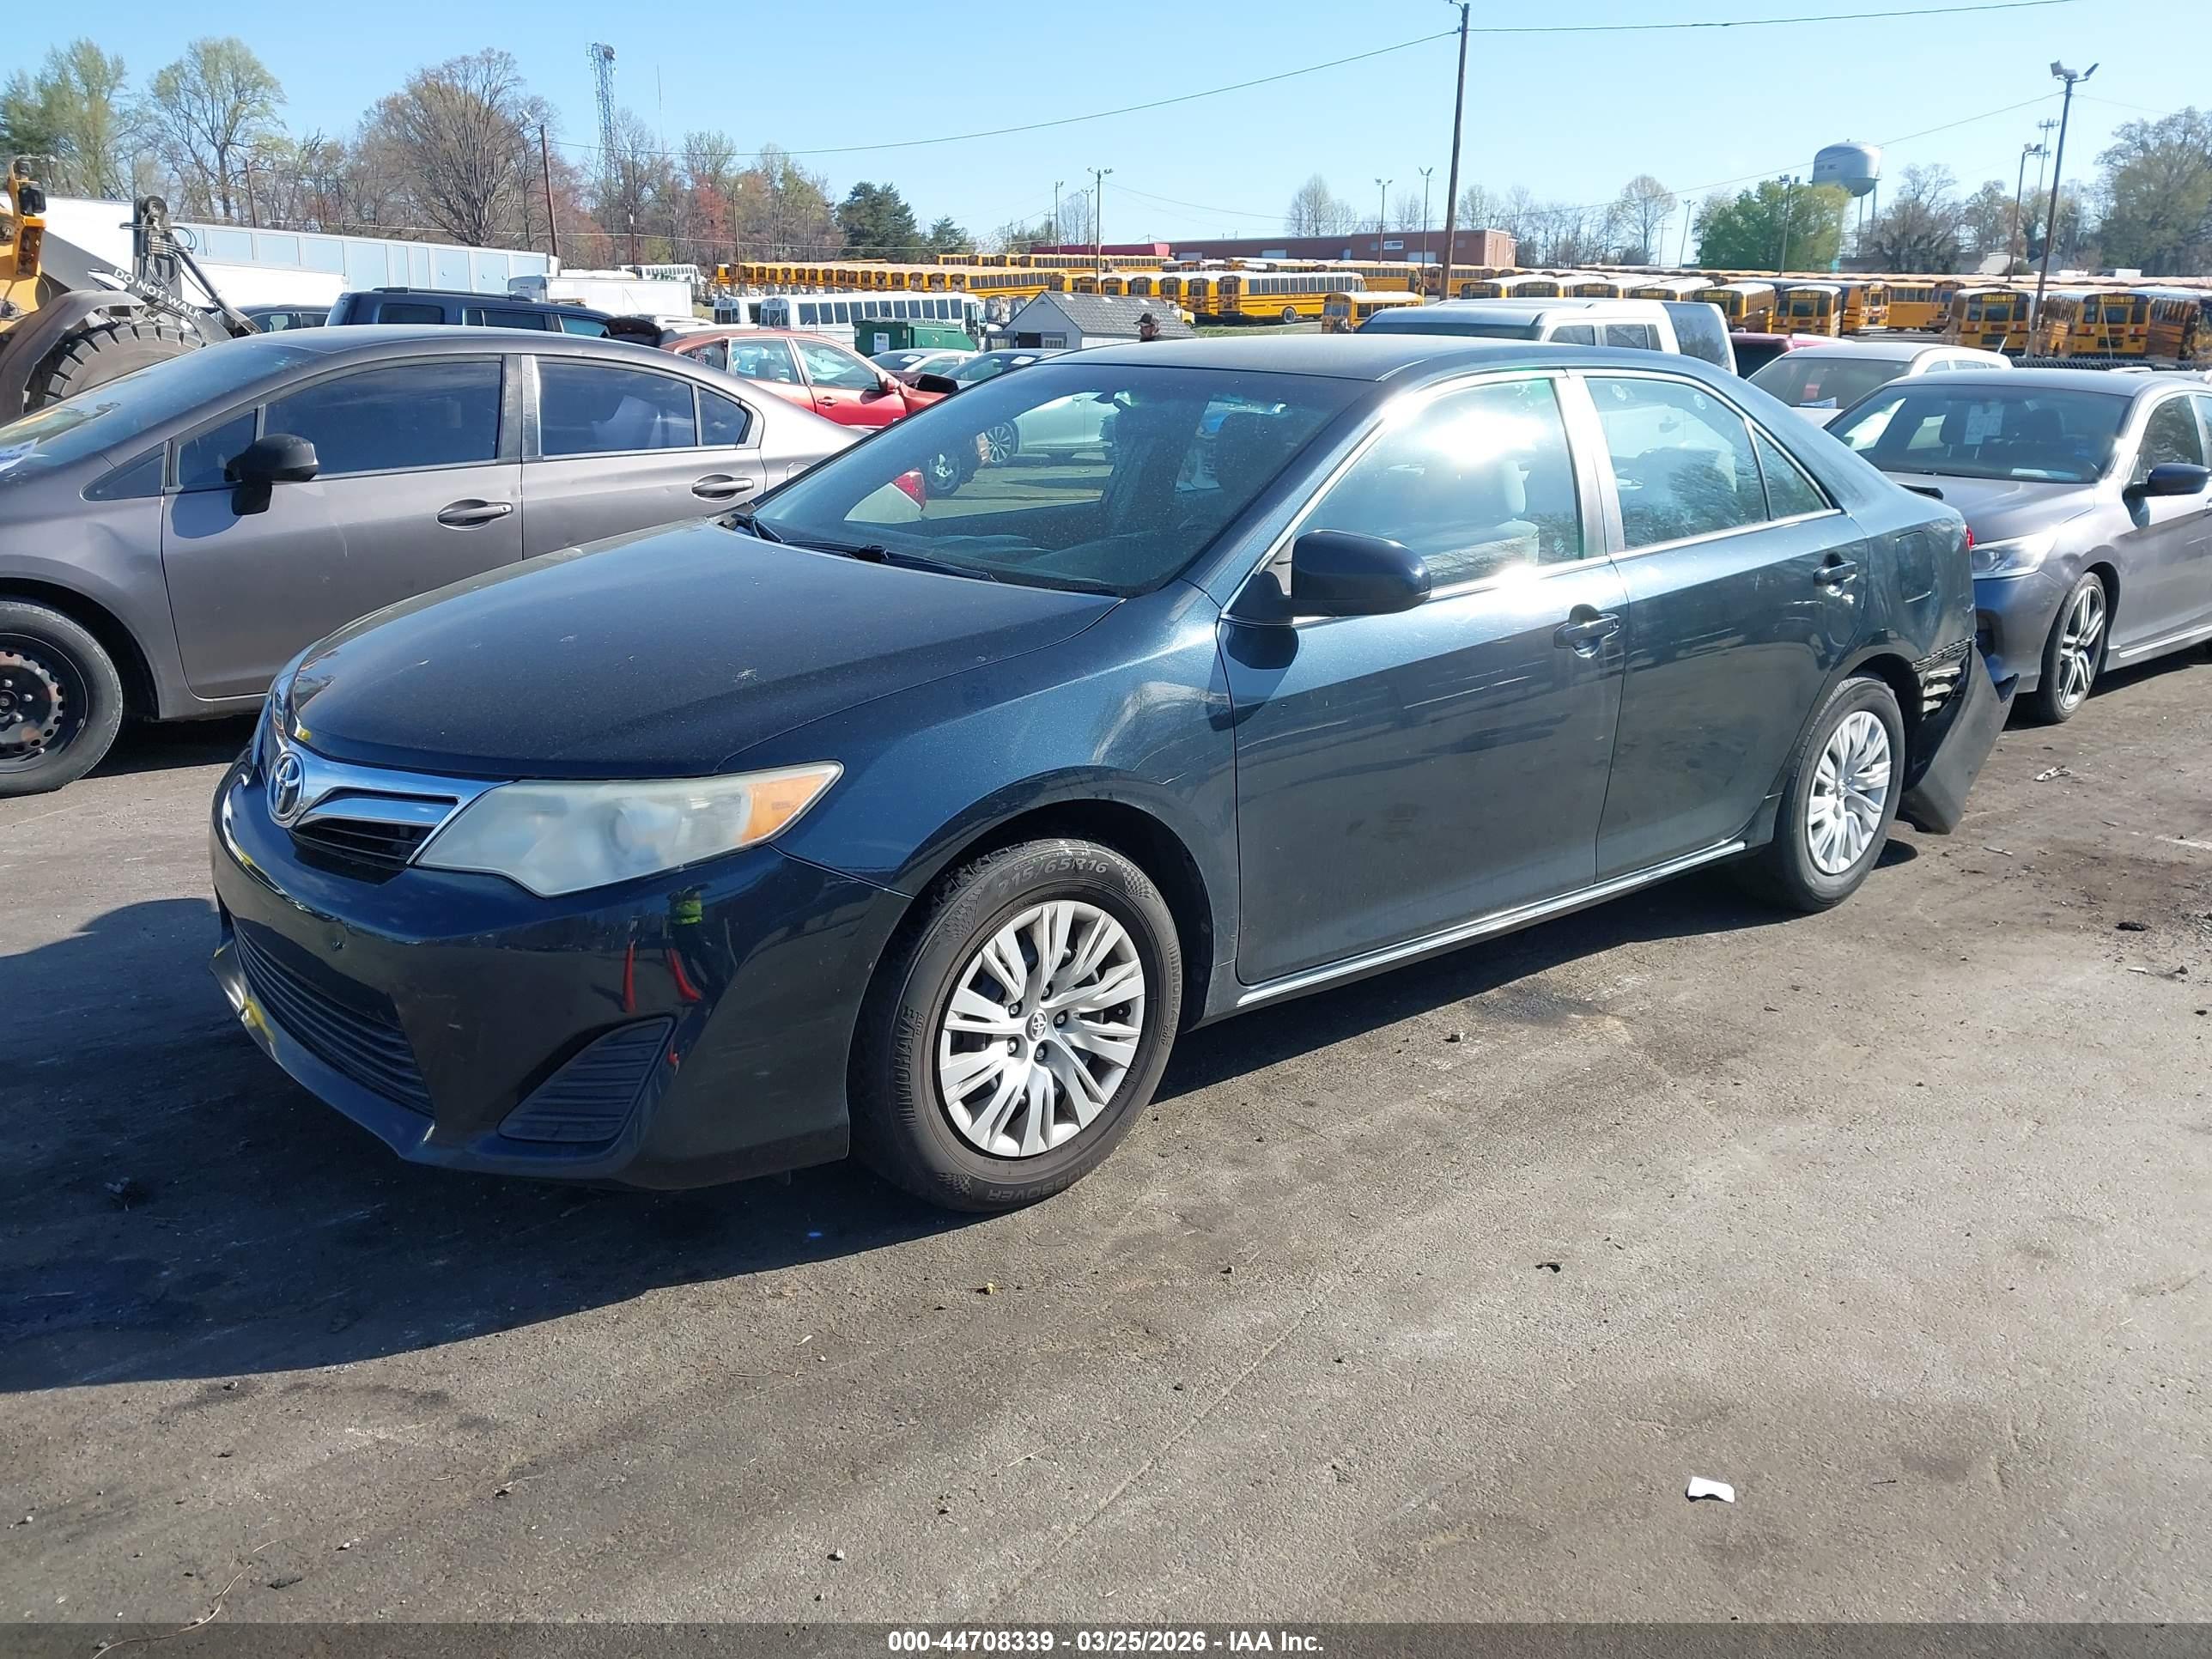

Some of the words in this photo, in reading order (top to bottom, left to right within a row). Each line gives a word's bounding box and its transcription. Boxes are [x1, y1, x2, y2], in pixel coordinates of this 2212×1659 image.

[113, 268, 134, 283] DO
[137, 279, 166, 299] NOT
[167, 295, 203, 320] WALK
[893, 1006, 920, 1106] MOHAVE
